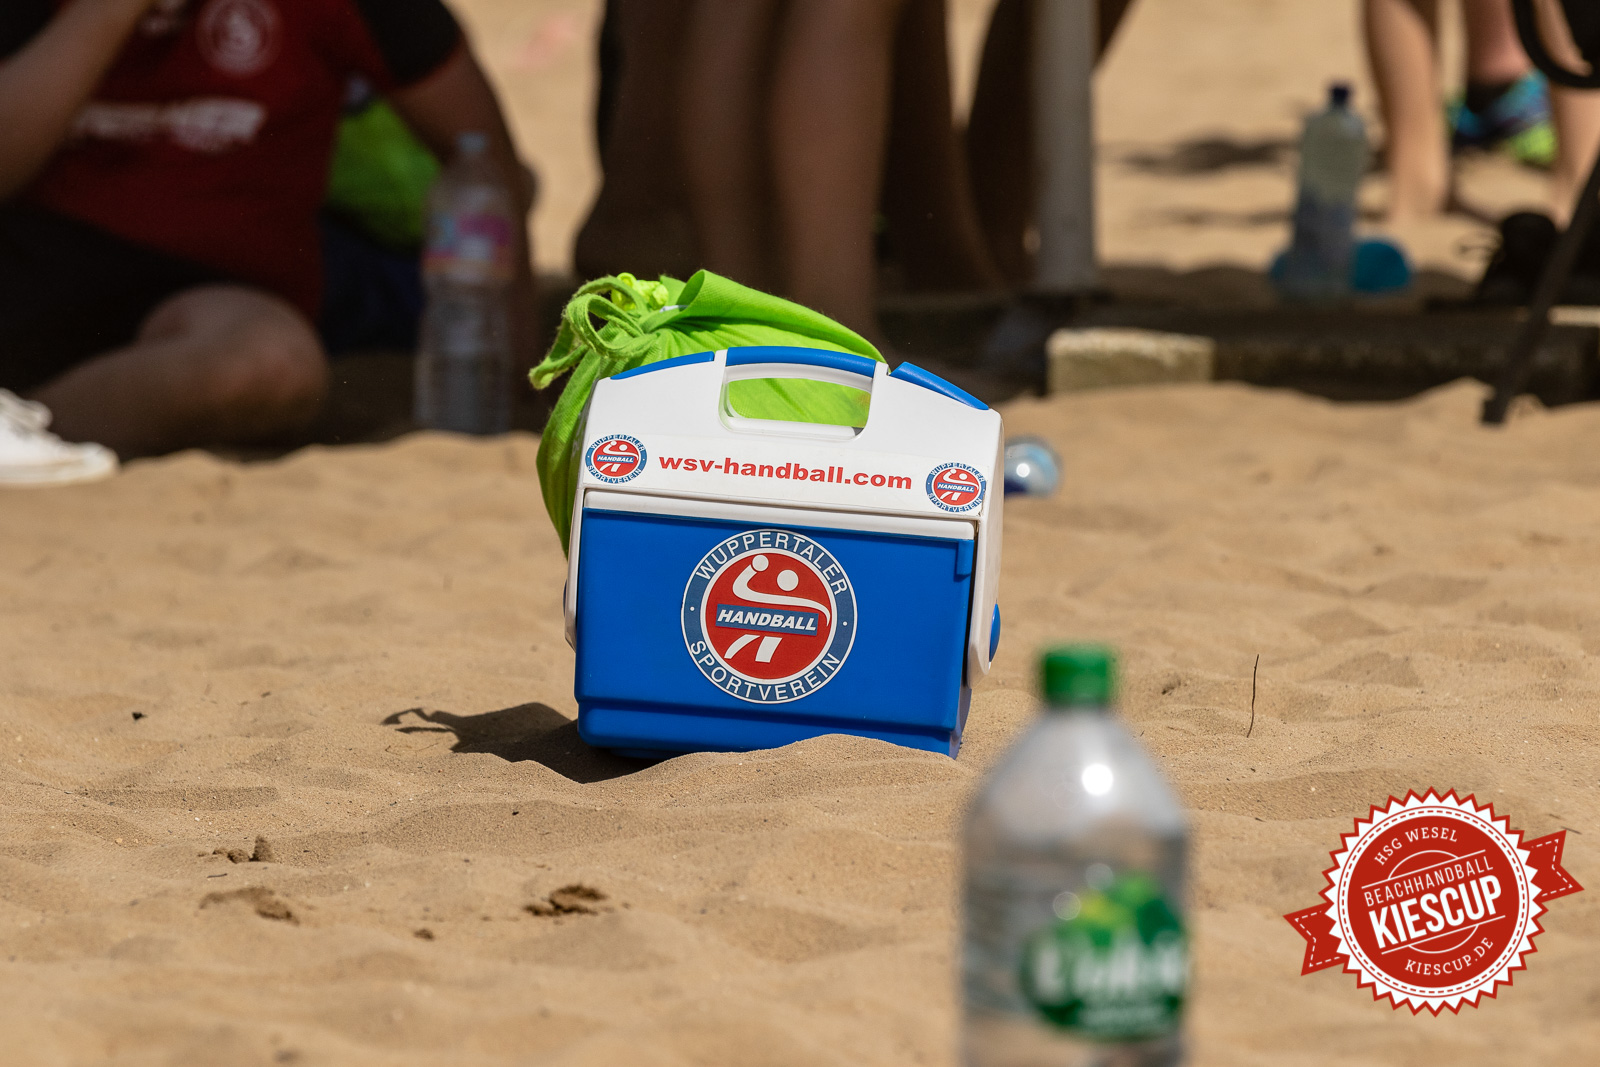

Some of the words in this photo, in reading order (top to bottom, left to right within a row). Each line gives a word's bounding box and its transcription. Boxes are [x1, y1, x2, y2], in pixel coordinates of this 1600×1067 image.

[590, 434, 645, 452] WUPPERTALER
[597, 455, 634, 463] HANDBALL
[587, 465, 642, 484] SPORTVEREIN
[659, 456, 912, 489] wsv-handball.com
[930, 462, 985, 483] WUPPERTALER
[937, 483, 975, 493] HANDBALL
[928, 492, 983, 513] SPORTVEREIN
[696, 531, 848, 596] WUPPERTALER
[717, 609, 817, 631] HANDBALL
[690, 640, 841, 701] SPORTVEREIN
